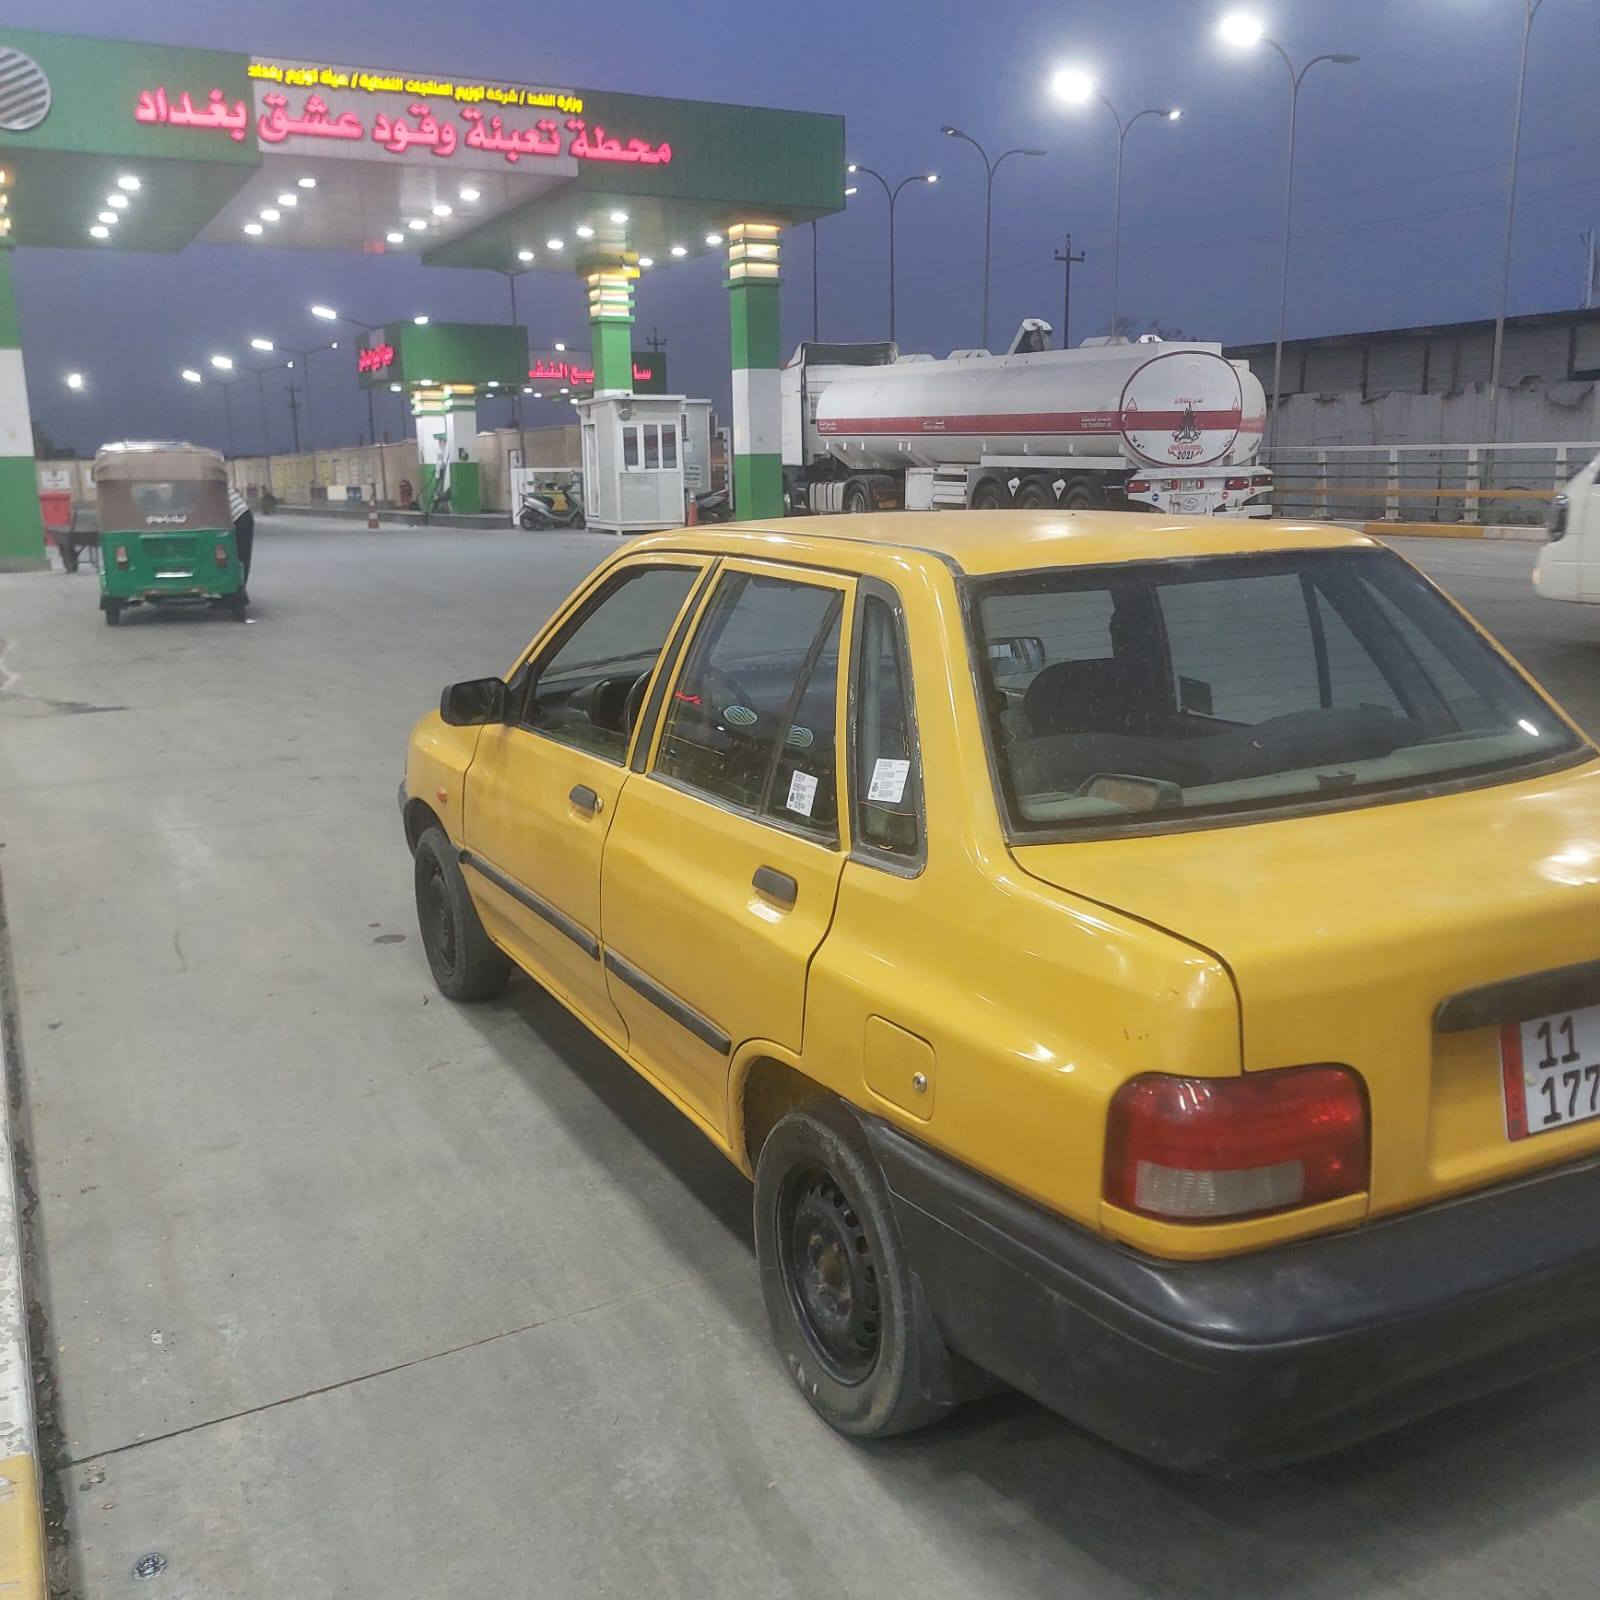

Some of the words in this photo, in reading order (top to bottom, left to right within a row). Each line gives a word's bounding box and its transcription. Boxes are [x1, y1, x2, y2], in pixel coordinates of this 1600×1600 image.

[134, 87, 248, 141] بغداد
[257, 92, 364, 142] عشق
[454, 85, 485, 103] توزيع
[486, 88, 518, 105] شركة
[527, 93, 556, 112] النفط
[557, 94, 583, 114] وزارة
[371, 103, 459, 156] وقود
[461, 106, 561, 162] تعبئة
[567, 117, 672, 164] محطة
[1537, 1015, 1580, 1070] 11
[1541, 1063, 1600, 1125] 177
